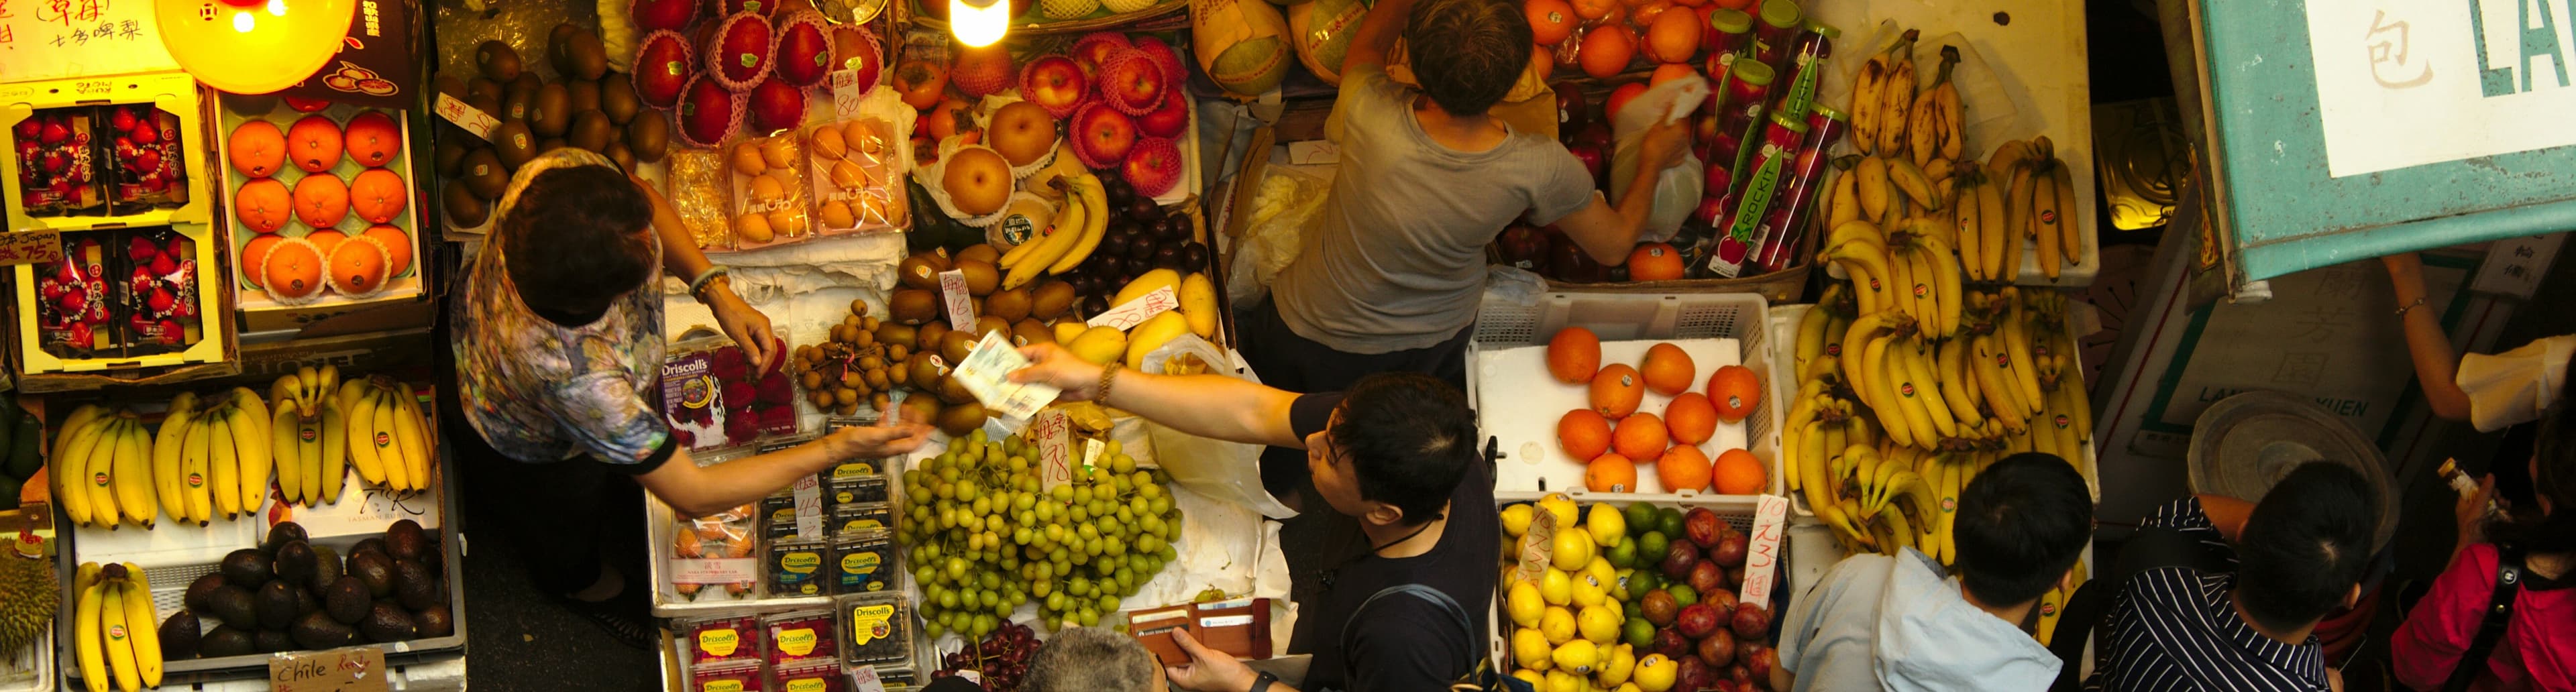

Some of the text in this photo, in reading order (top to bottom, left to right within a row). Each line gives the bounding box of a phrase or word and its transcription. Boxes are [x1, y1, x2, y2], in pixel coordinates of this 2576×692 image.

[49, 19, 143, 47] 士多啤梨
[2365, 9, 2434, 89] 包
[2469, 0, 2576, 98] LA
[837, 93, 859, 115] 80
[1792, 75, 1810, 119] OCKIT
[1743, 167, 1774, 226] ROCKIT
[20, 232, 56, 245] Japan
[91, 281, 104, 320] 恋みのり
[951, 298, 968, 316] 16
[661, 359, 708, 376] Driscoll's
[798, 497, 822, 517] 45
[348, 514, 382, 523] TASMAN
[845, 557, 877, 565] Driscoll's
[856, 607, 890, 616] Driscoll's
[702, 634, 736, 642] Driscoll's
[780, 634, 814, 643] Driscoll's
[278, 660, 326, 681] Chile
[790, 682, 824, 690] Driscoll's
